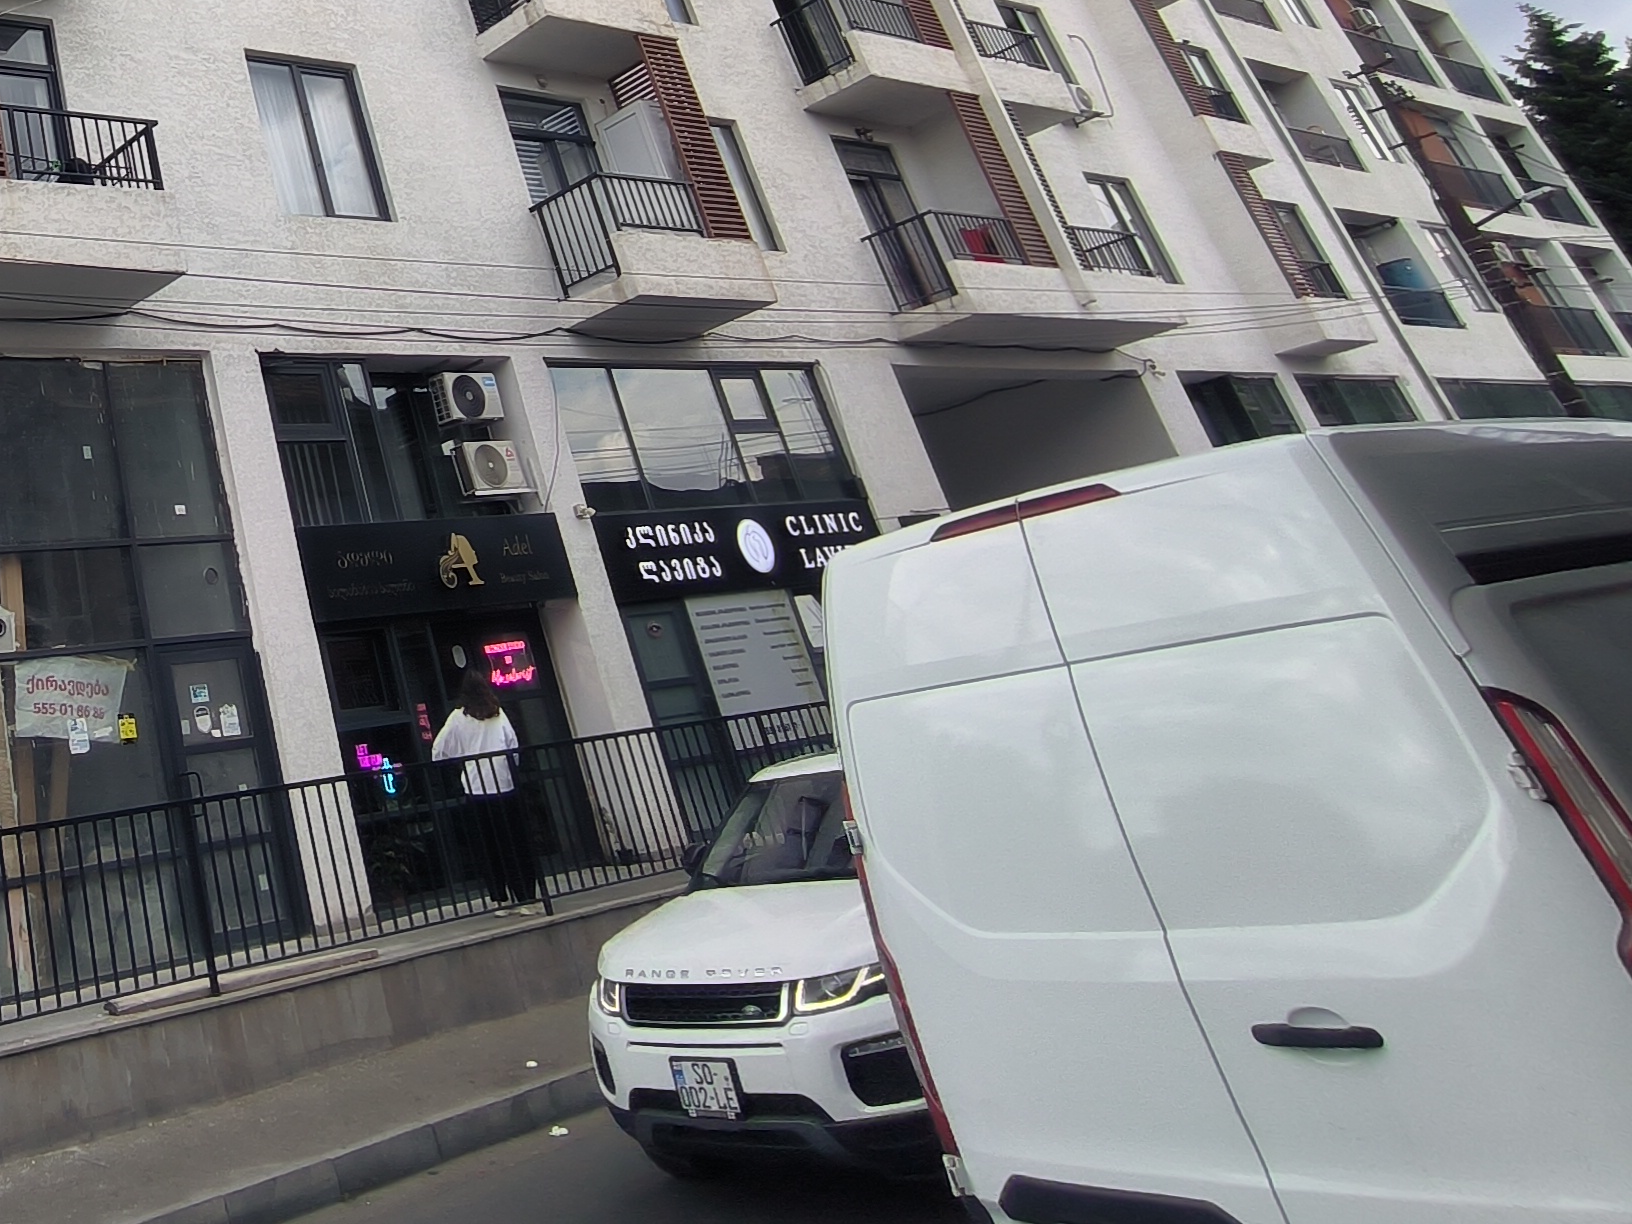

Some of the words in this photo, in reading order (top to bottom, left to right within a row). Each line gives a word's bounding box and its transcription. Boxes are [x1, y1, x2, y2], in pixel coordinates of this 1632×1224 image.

[625, 521, 716, 550] კლინიკა
[784, 511, 864, 537] CLINIC
[502, 533, 534, 557] Adel
[638, 555, 722, 583] ლავიტა
[26, 675, 110, 698] ქირავდება
[33, 702, 57, 715] 555
[59, 703, 74, 716] 01
[625, 968, 690, 979] RANGE
